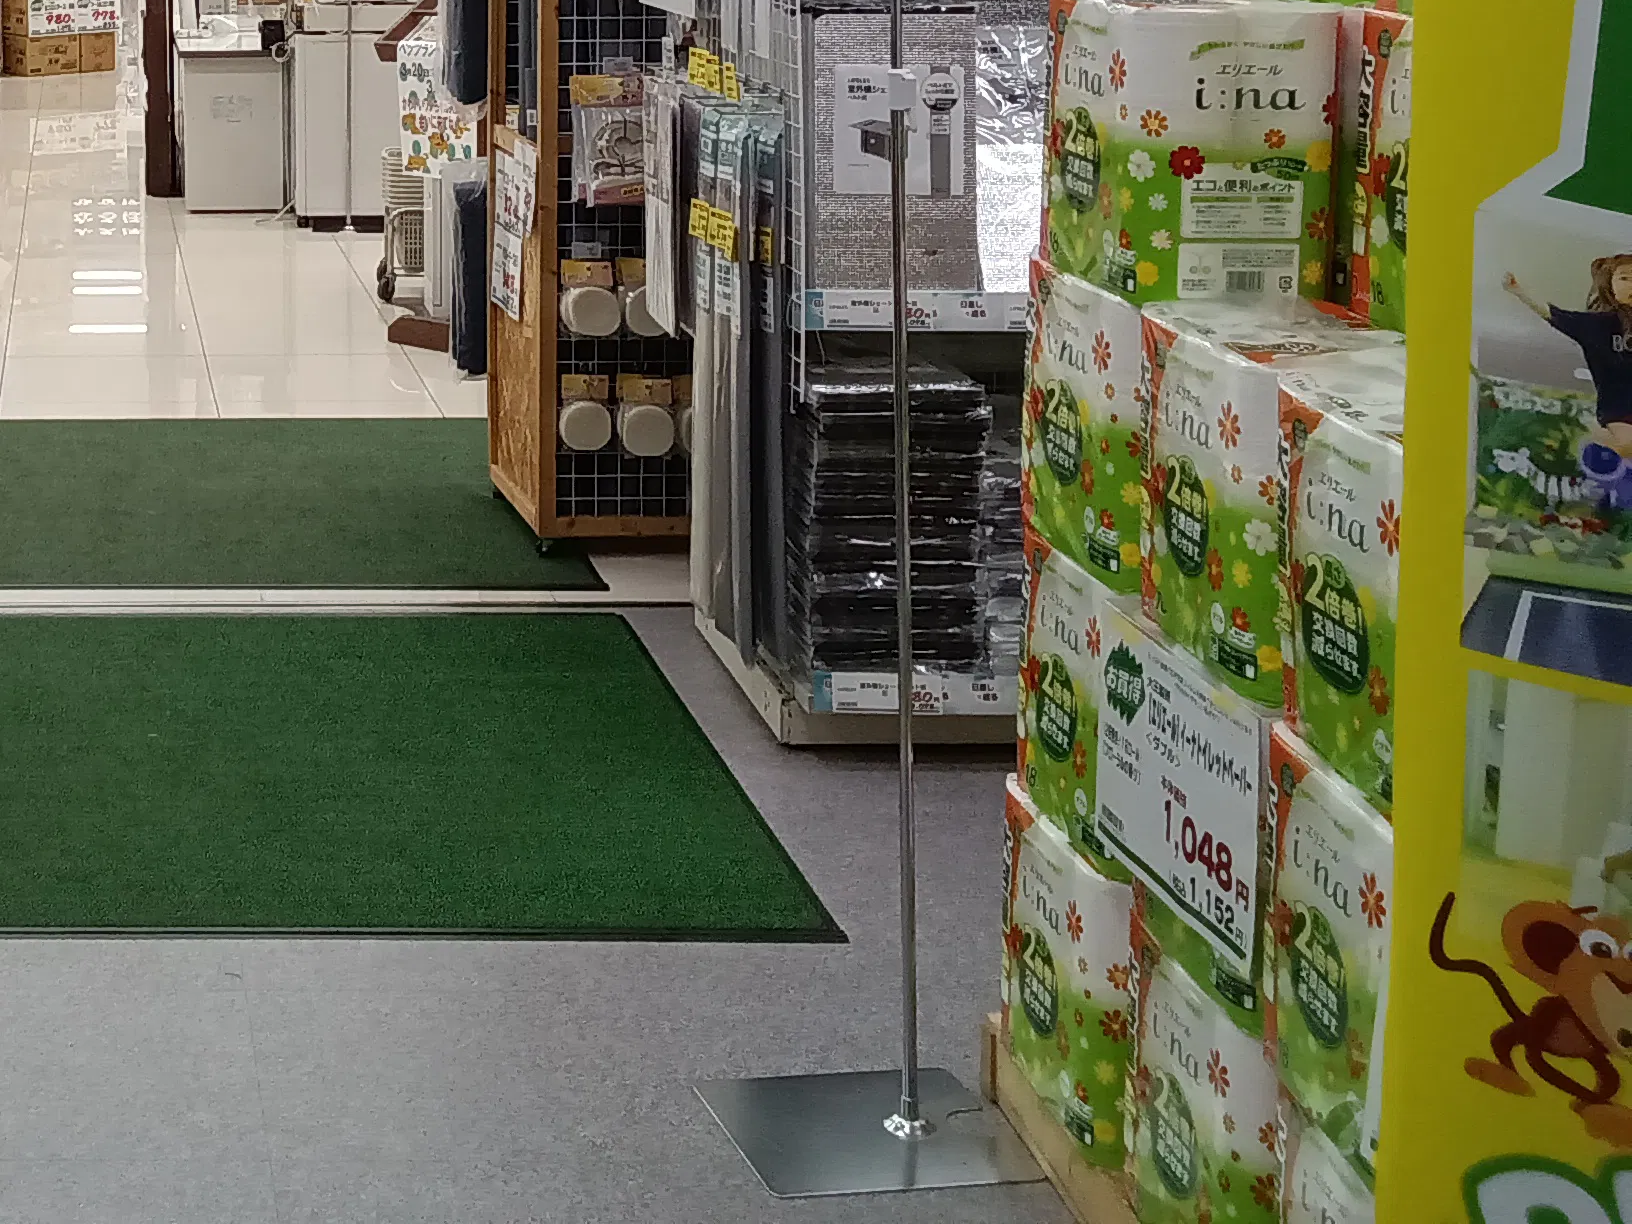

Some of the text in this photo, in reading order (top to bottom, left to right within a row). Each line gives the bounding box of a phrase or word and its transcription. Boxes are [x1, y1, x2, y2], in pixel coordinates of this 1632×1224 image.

[1216, 63, 1283, 77] エリエール
[1194, 77, 1307, 112] i:na
[1106, 665, 1143, 706] お買得
